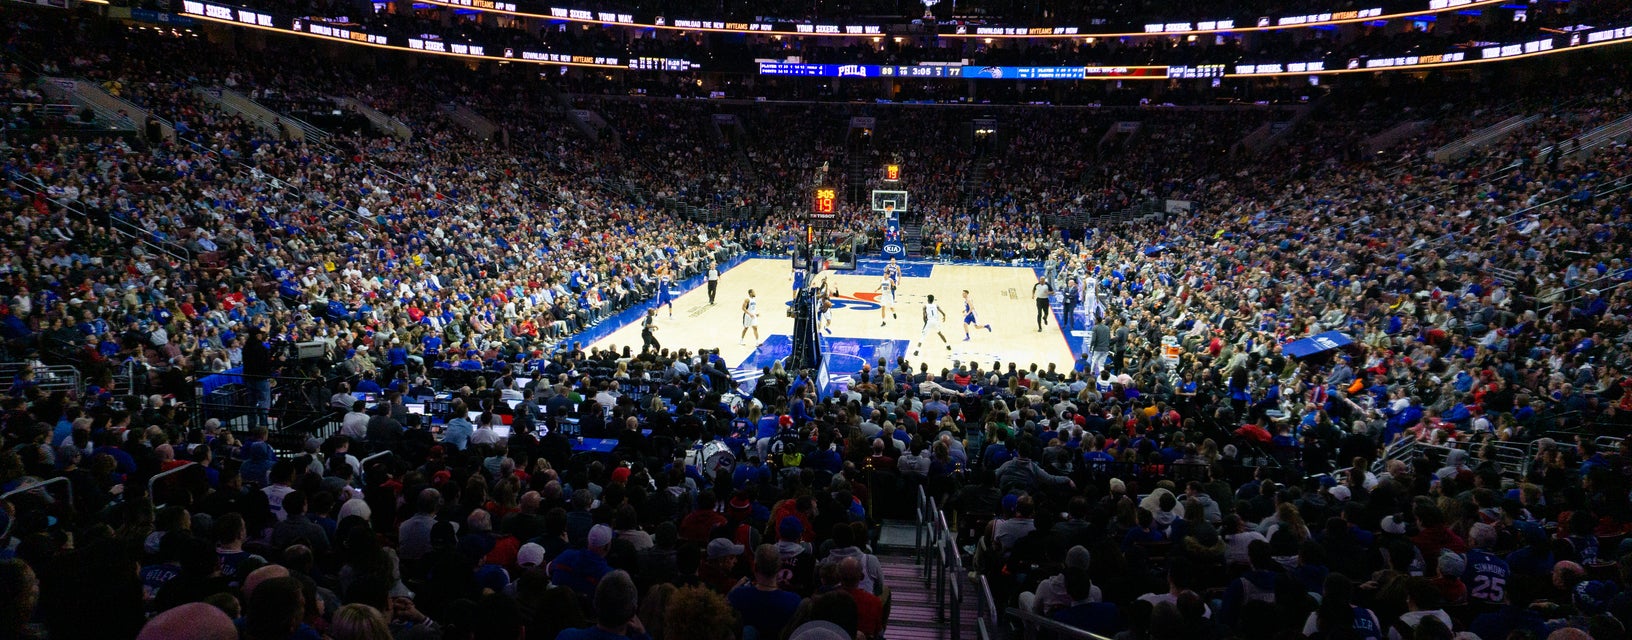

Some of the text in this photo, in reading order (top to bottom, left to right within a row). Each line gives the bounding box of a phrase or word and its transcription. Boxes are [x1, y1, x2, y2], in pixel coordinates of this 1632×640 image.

[551, 8, 593, 20] YOUR SIXERS.
[598, 13, 633, 23] YOUR WAY.
[796, 24, 840, 33] YOUR SIXERS.
[846, 25, 862, 33] YOUR
[408, 38, 445, 52] YOUR SIXERS.
[451, 44, 484, 55] YOUR WAY.
[522, 52, 548, 60] DOWNLOAD
[572, 55, 593, 64] MYTEAMS
[838, 65, 866, 76] PHILA
[913, 68, 931, 76] 3:05
[818, 190, 835, 199] 3:05
[820, 199, 832, 212] 19
[1474, 563, 1506, 576] SIMMONS
[1471, 574, 1506, 600] 25
